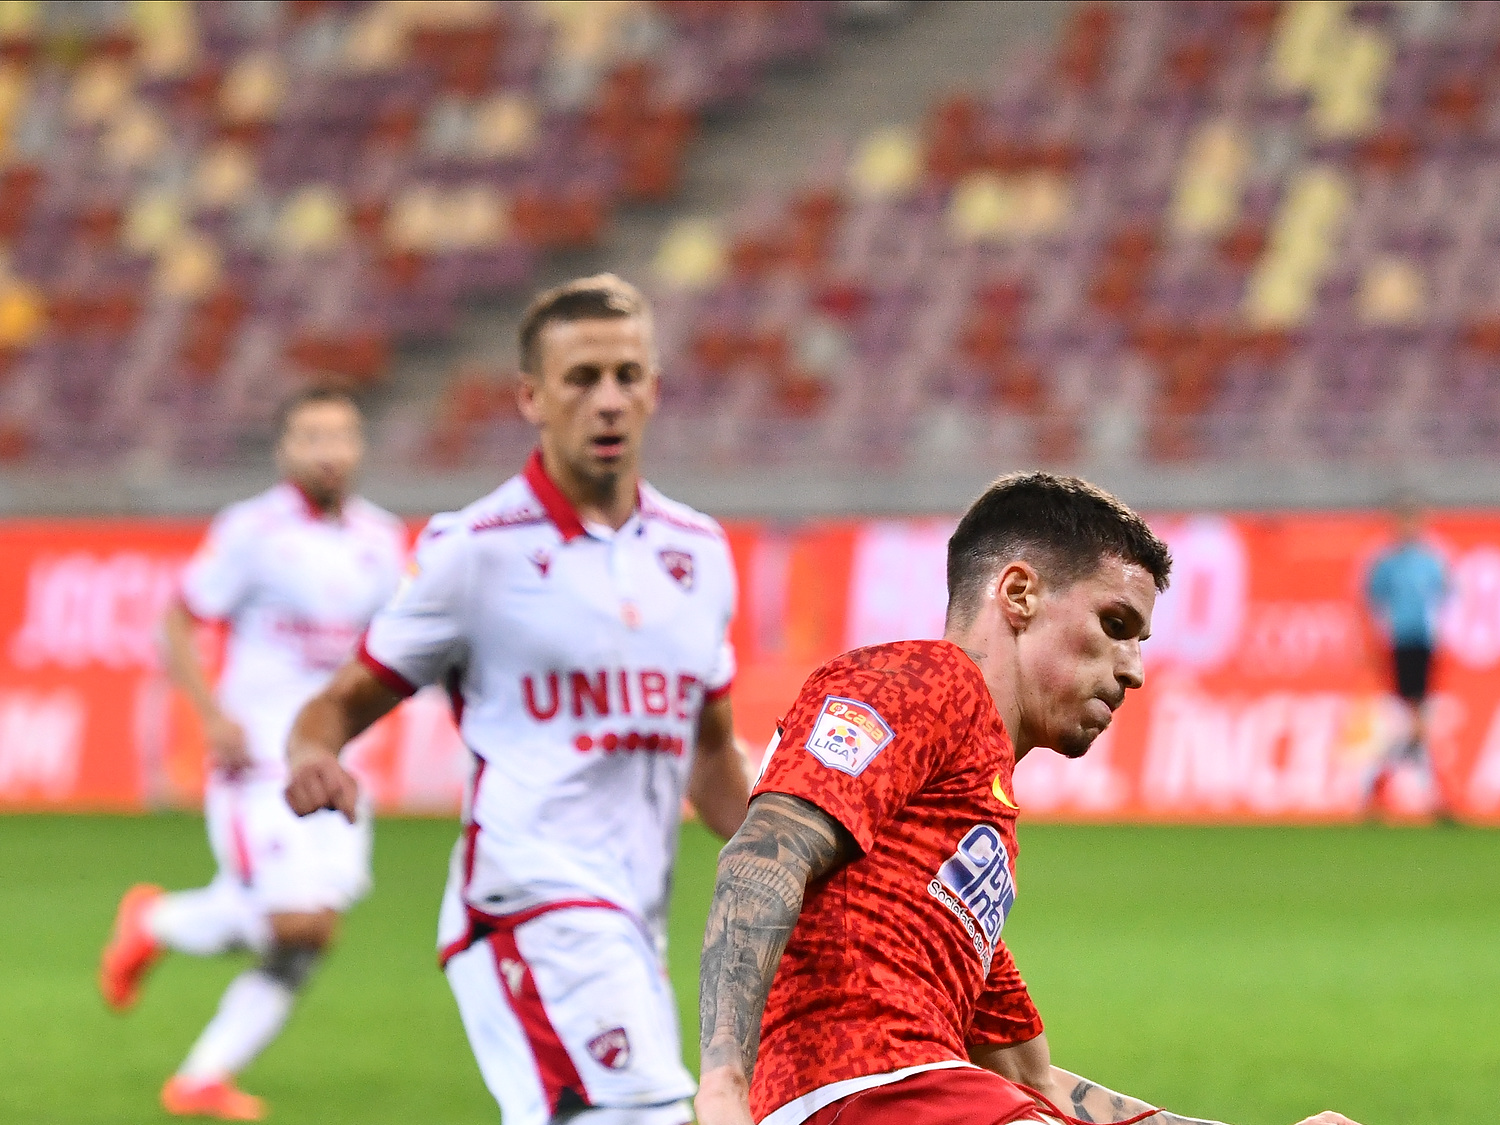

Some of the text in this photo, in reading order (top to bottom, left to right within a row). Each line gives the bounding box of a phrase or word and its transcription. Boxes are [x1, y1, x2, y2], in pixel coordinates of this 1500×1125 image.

[521, 667, 705, 721] UNIBE
[814, 737, 850, 762] LIGA
[929, 880, 976, 938] Societate
